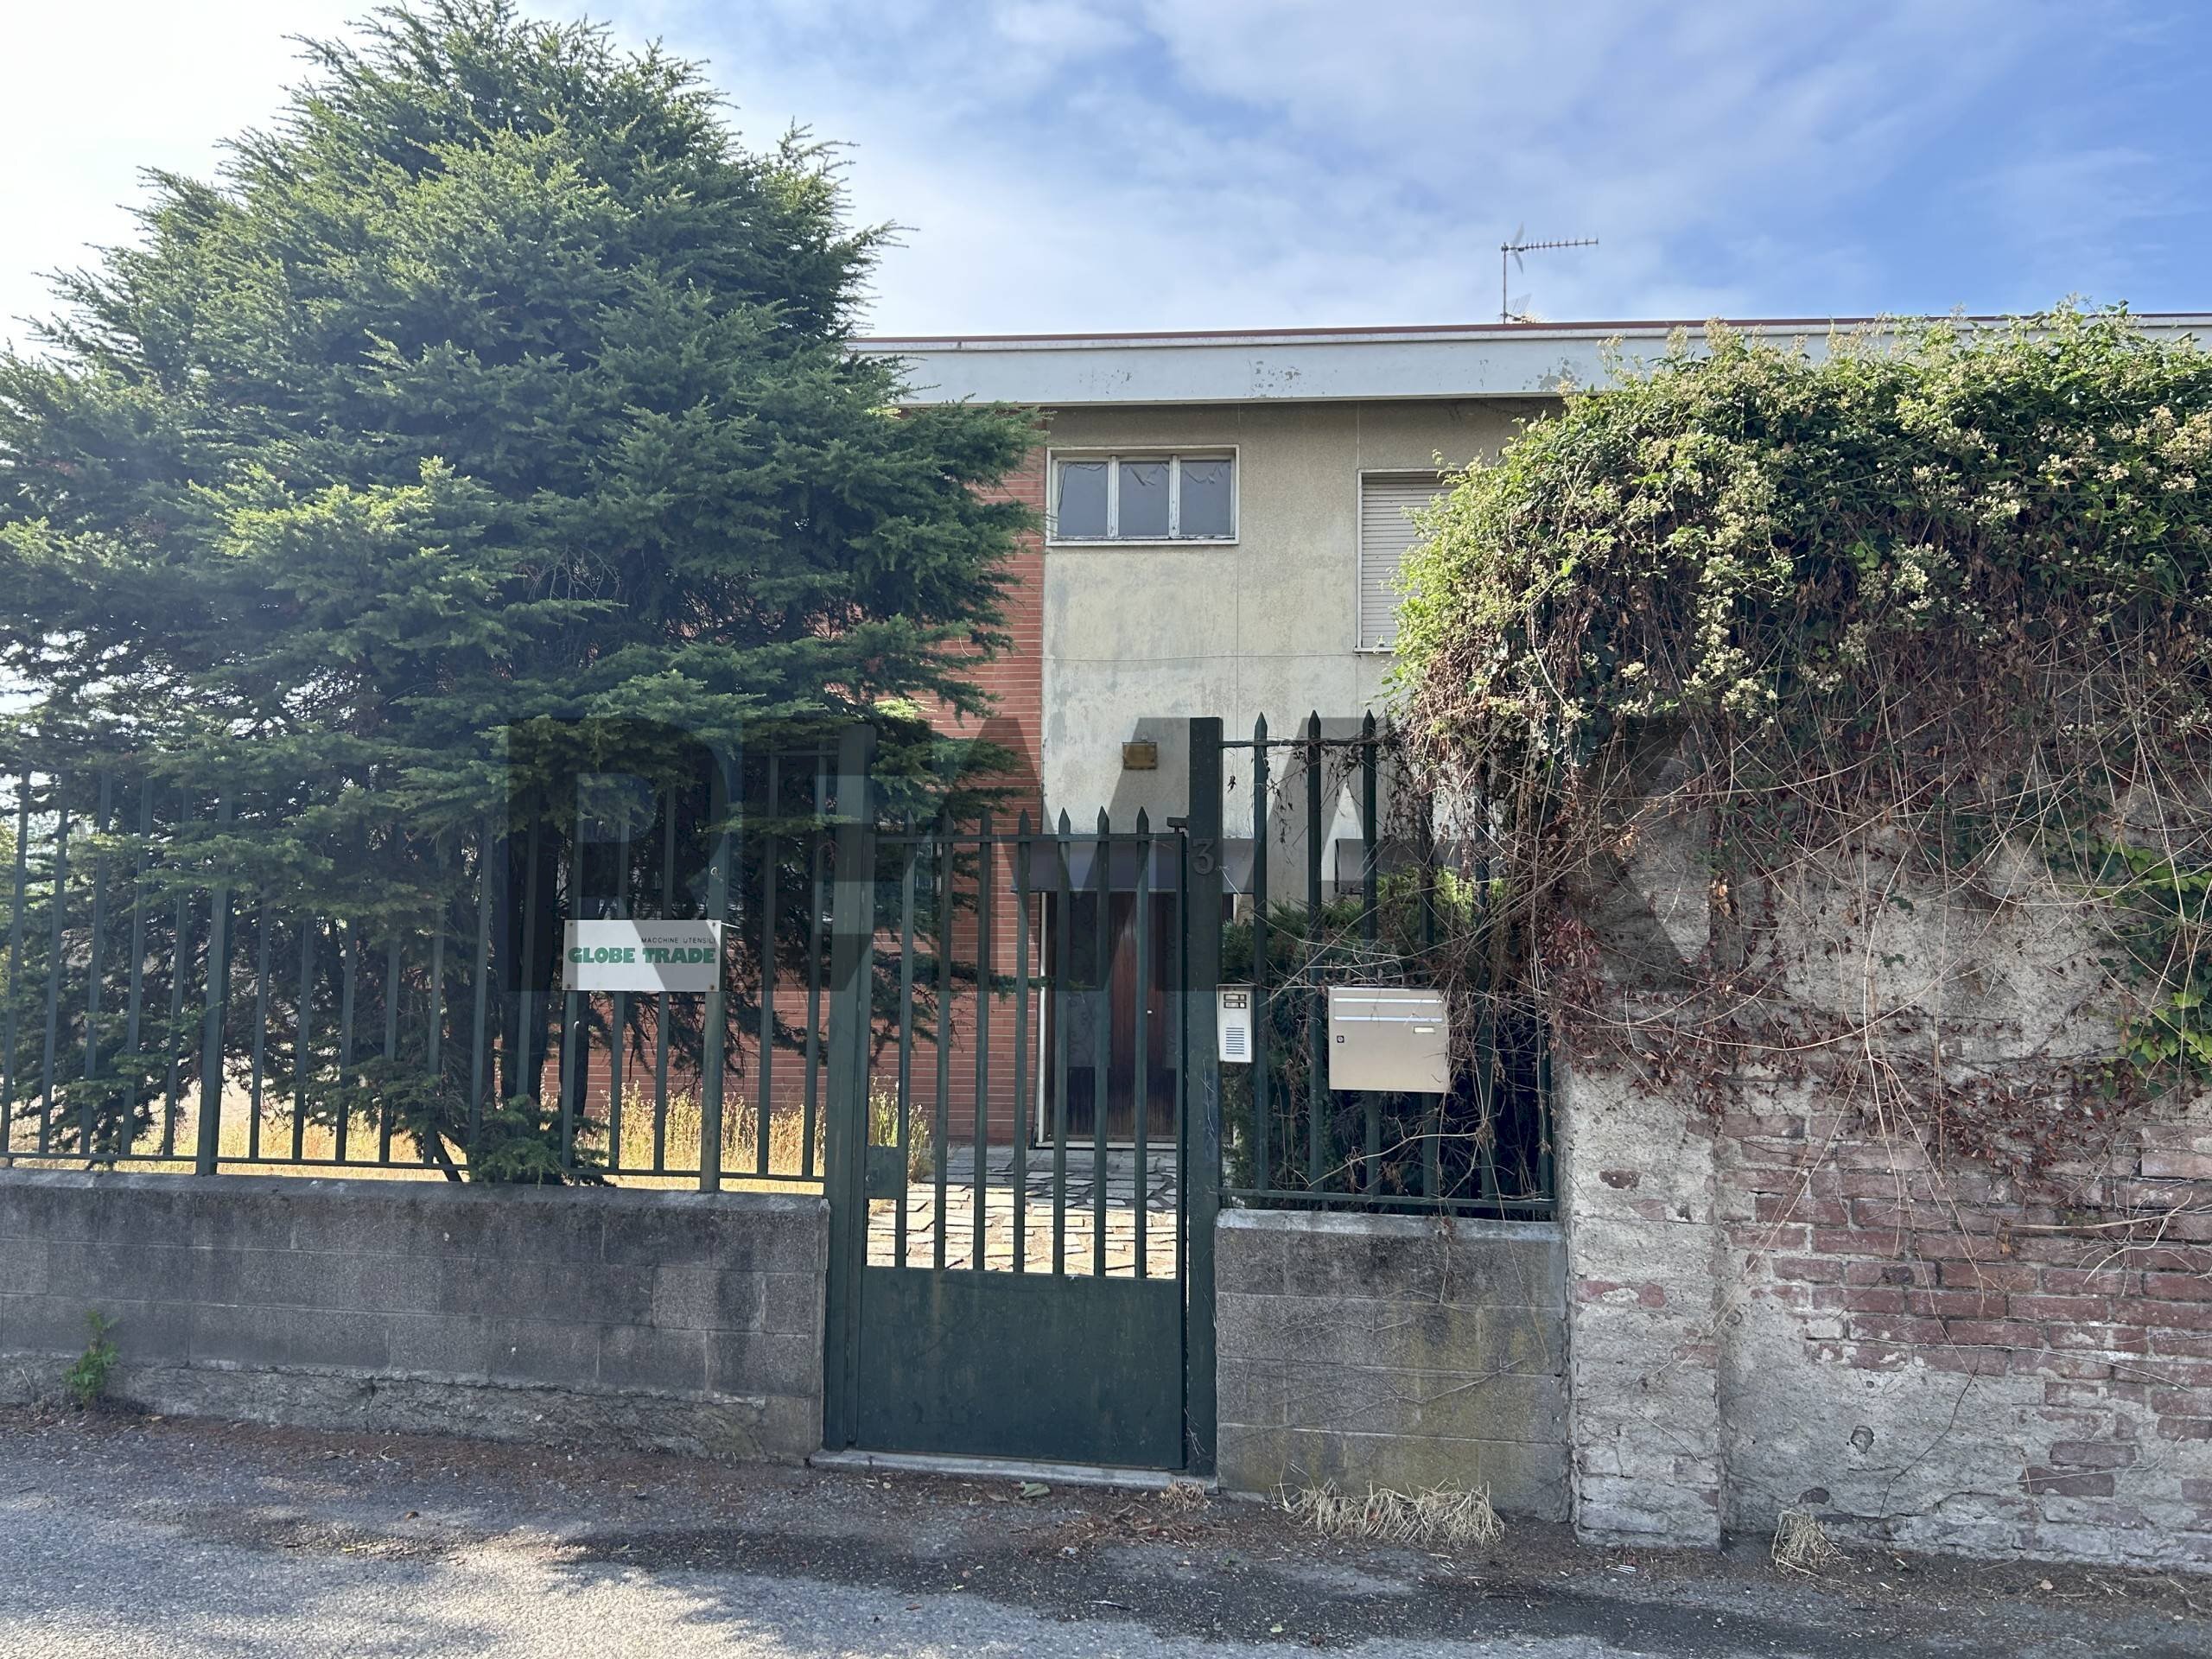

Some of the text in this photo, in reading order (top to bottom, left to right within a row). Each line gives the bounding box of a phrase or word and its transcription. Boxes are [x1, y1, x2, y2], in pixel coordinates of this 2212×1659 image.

[1192, 838, 1215, 875] 3
[568, 947, 716, 963] GLOBE TRADE
